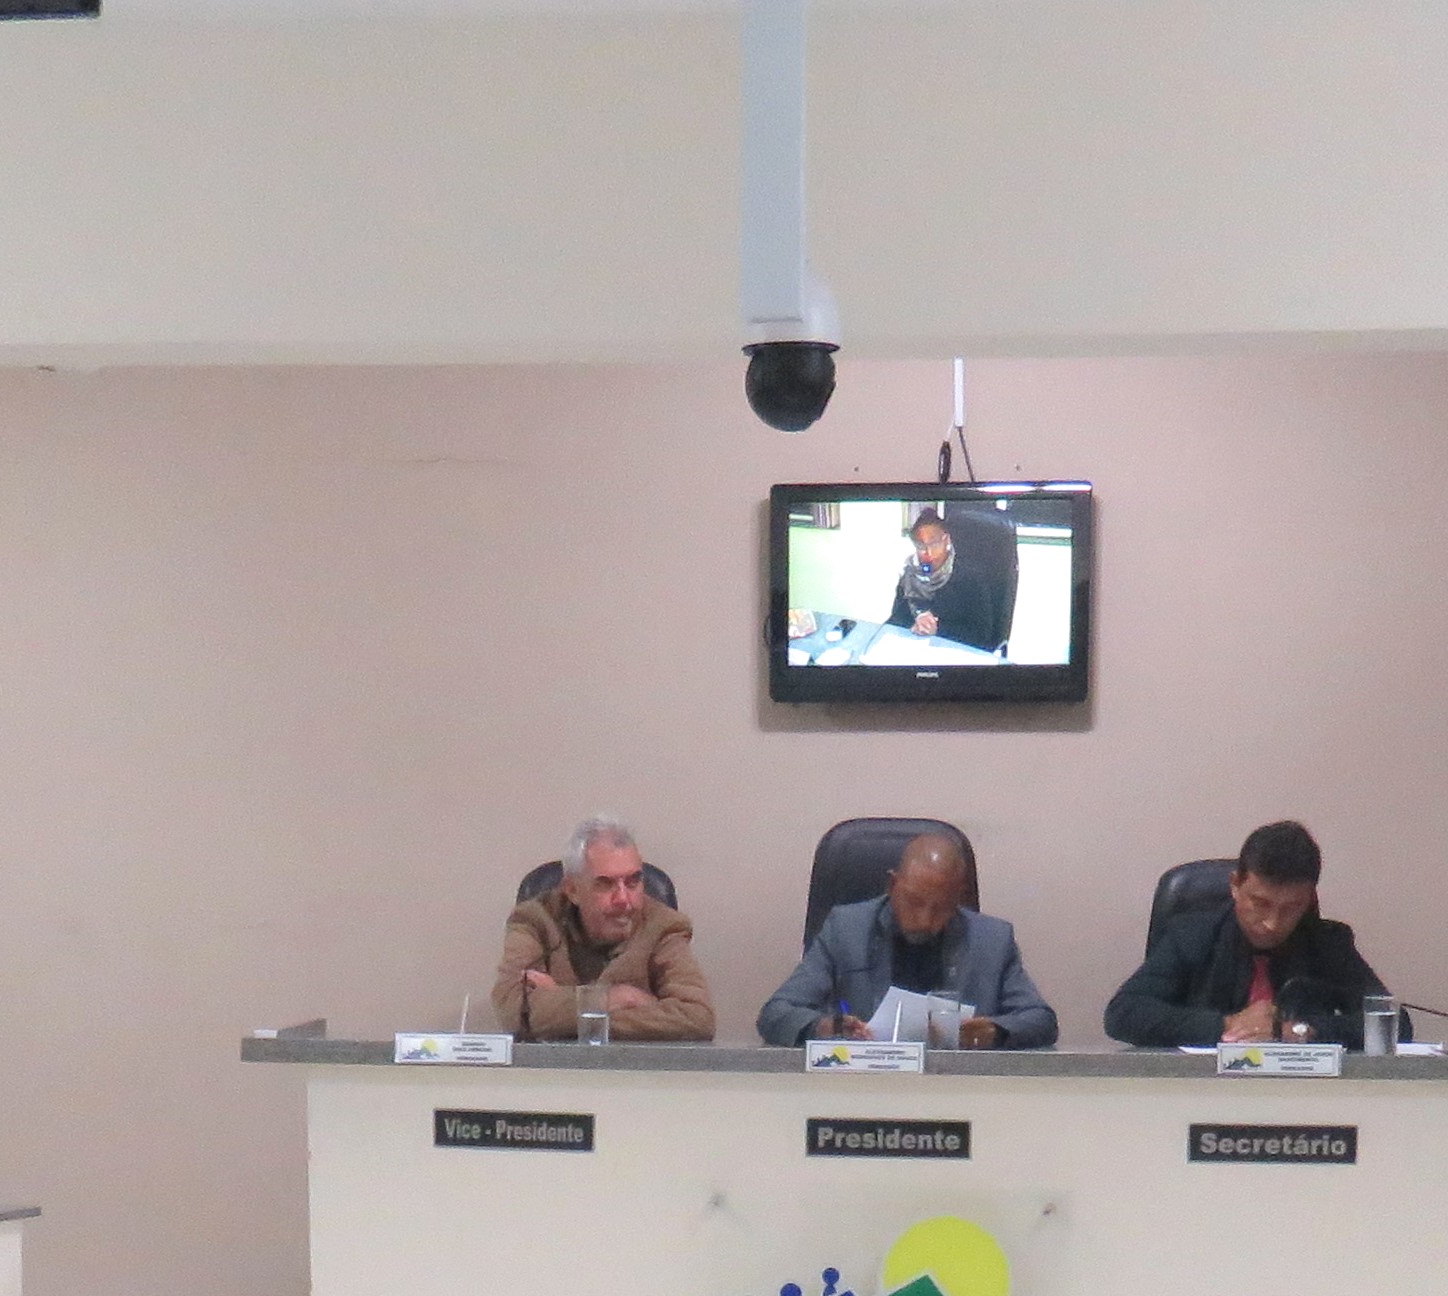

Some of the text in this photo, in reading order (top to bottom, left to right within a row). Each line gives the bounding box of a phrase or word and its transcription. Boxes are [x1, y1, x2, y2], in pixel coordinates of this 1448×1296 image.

[444, 1119, 482, 1140] Vice
[495, 1120, 585, 1143] Presidente
[817, 1127, 962, 1151] Presidente
[1199, 1132, 1348, 1156] Secretário
